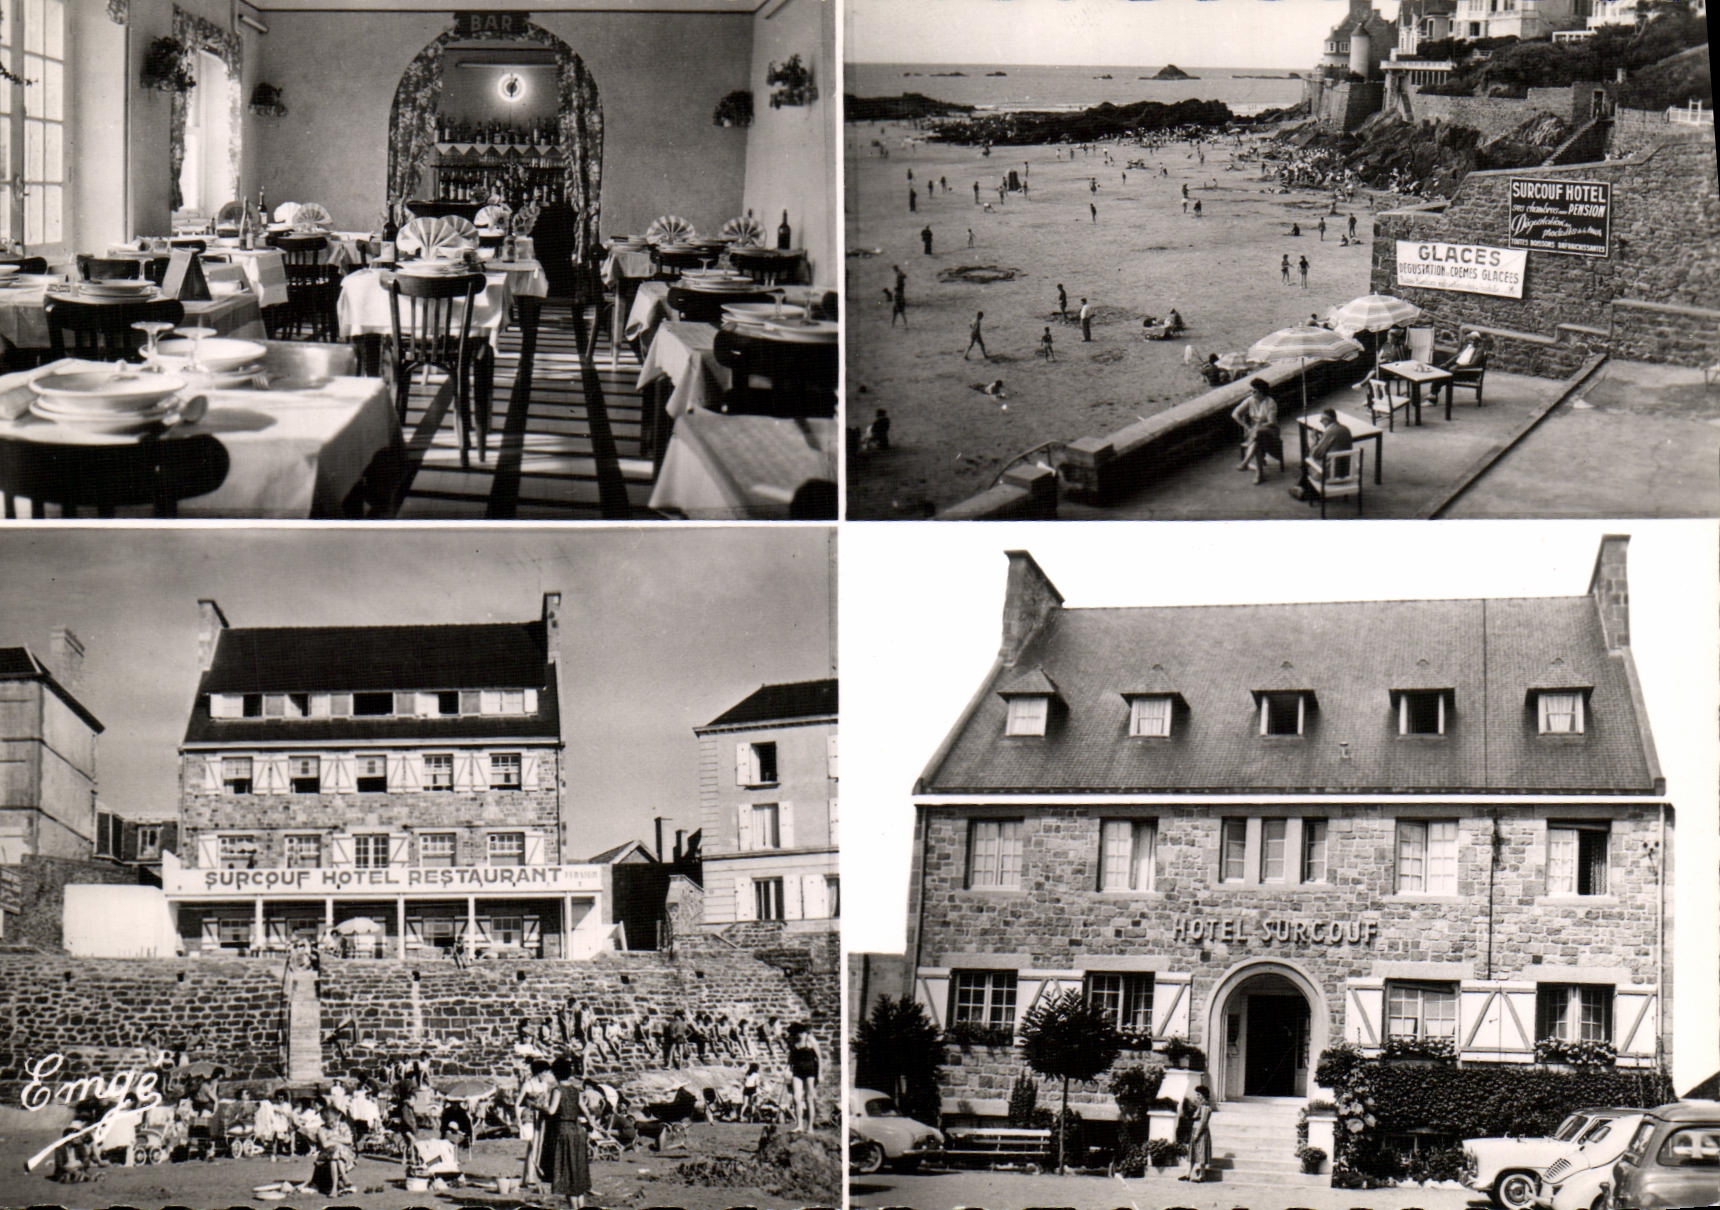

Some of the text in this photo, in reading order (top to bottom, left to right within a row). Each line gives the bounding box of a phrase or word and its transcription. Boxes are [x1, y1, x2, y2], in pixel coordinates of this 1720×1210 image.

[470, 15, 513, 31] BAR
[1512, 181, 1606, 203] SURCOUF HOTEL
[1568, 203, 1606, 218] PENSION
[1418, 244, 1501, 267] GLACES
[205, 871, 310, 886] SURCOUF
[322, 871, 399, 885] HOTEL
[408, 868, 562, 885] RESTAURANT
[1173, 919, 1378, 947] HOTEL SURCOUF
